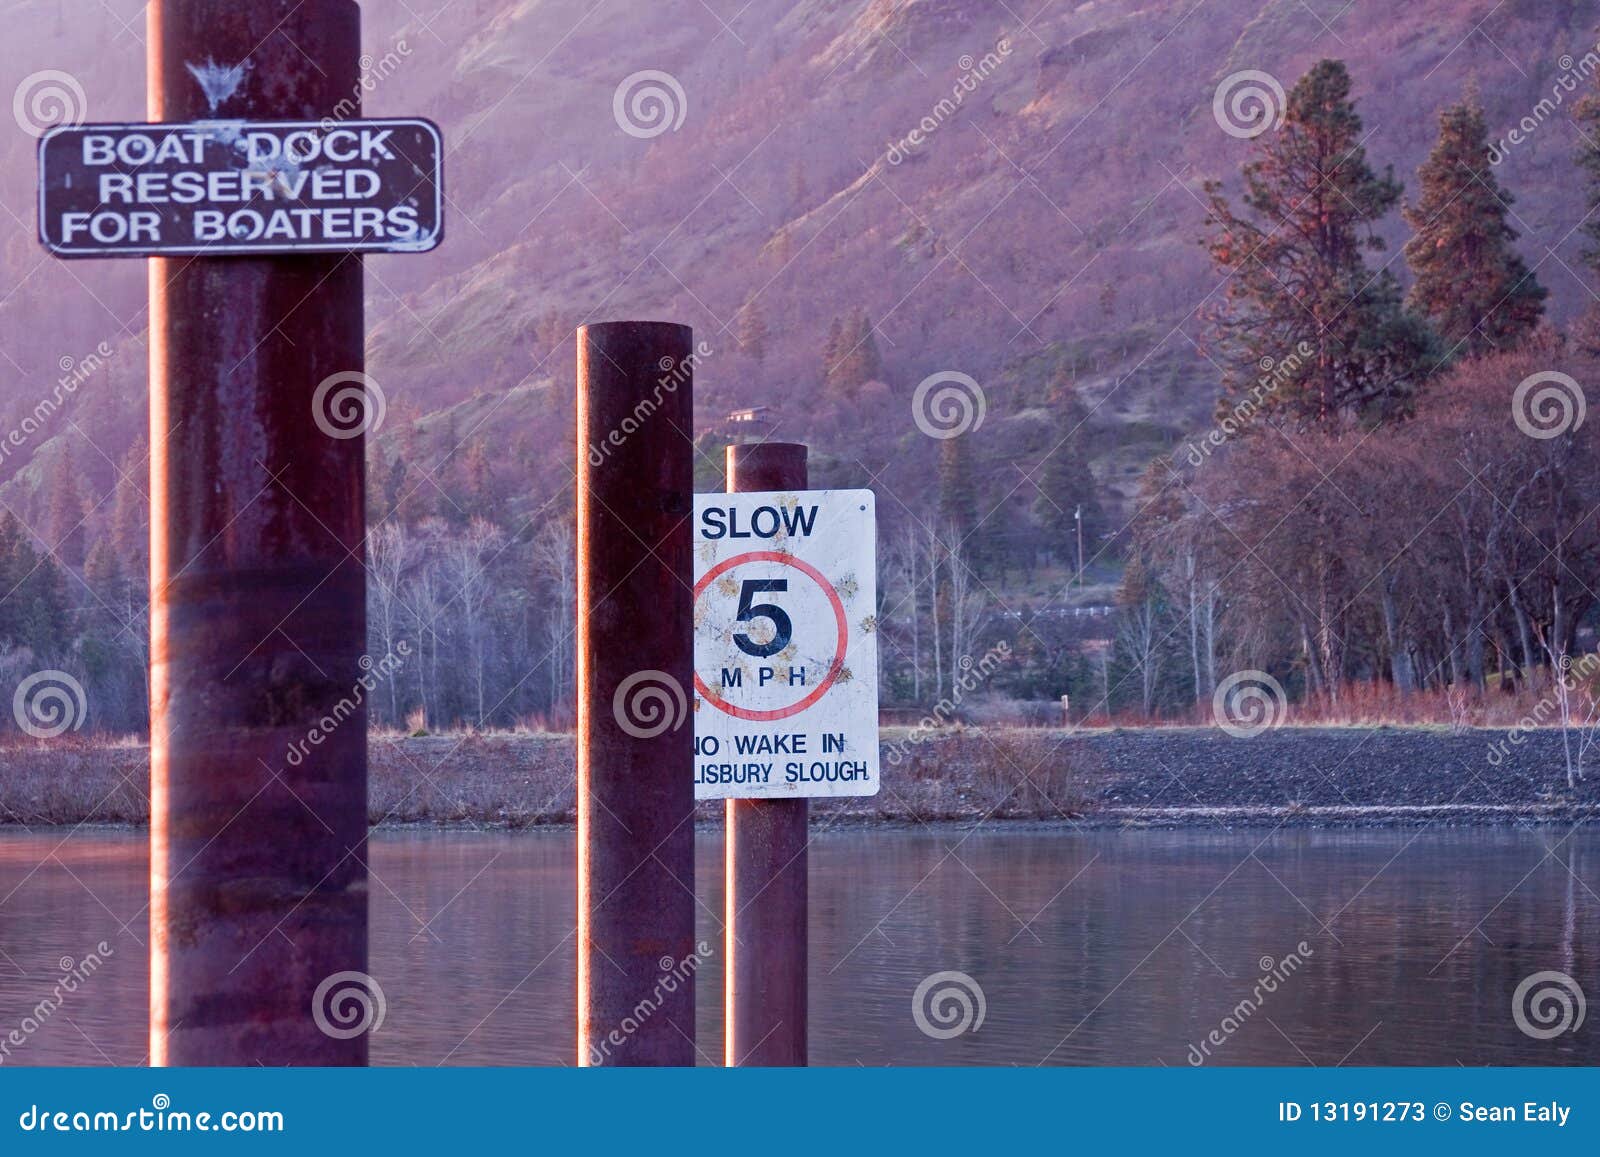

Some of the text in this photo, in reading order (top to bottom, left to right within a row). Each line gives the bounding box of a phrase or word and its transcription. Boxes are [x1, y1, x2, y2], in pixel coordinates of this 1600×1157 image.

[82, 129, 396, 166] BOAT DOCK
[100, 169, 381, 204] RESERVED
[61, 205, 419, 243] FOR BOATERS
[701, 505, 819, 540] SLOW
[733, 578, 793, 658] 5
[734, 734, 807, 755] WAKE
[822, 733, 844, 753] IN
[785, 761, 867, 782] SLOUGH
